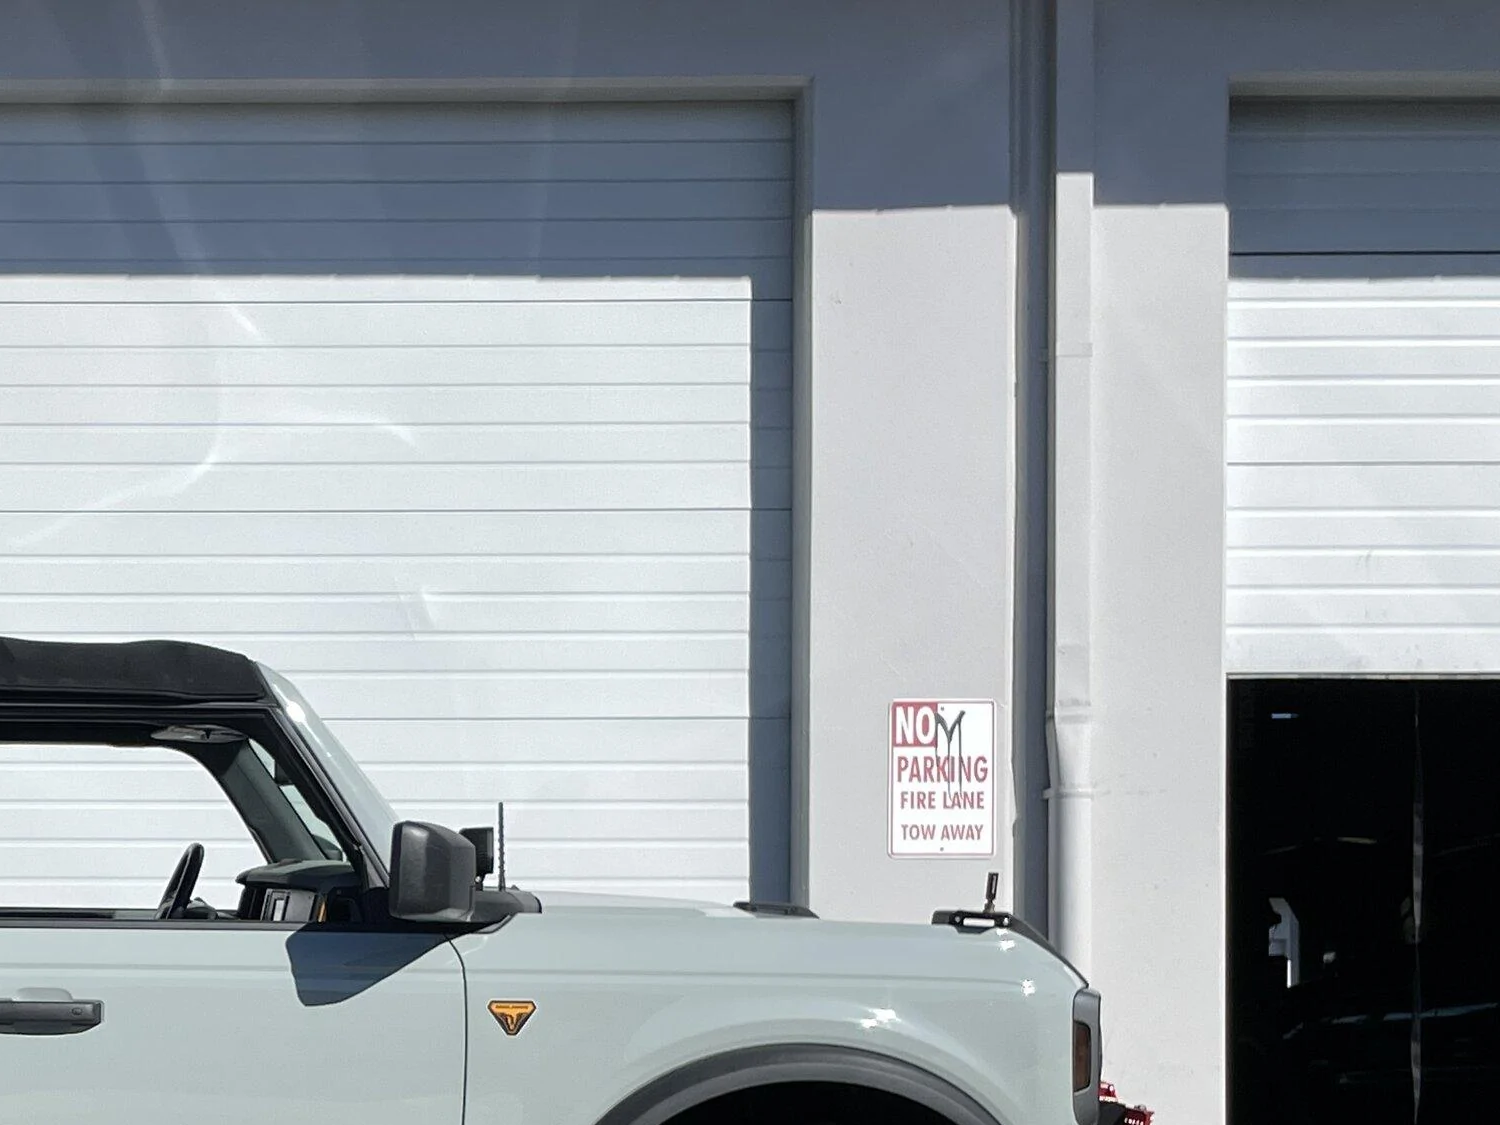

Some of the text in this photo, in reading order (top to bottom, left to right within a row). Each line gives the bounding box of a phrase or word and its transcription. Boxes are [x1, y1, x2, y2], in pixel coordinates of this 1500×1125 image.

[895, 706, 936, 744] NO
[897, 756, 988, 783] PARKING
[900, 791, 984, 809] FIRE LANE
[901, 824, 983, 840] TOW AWAY
